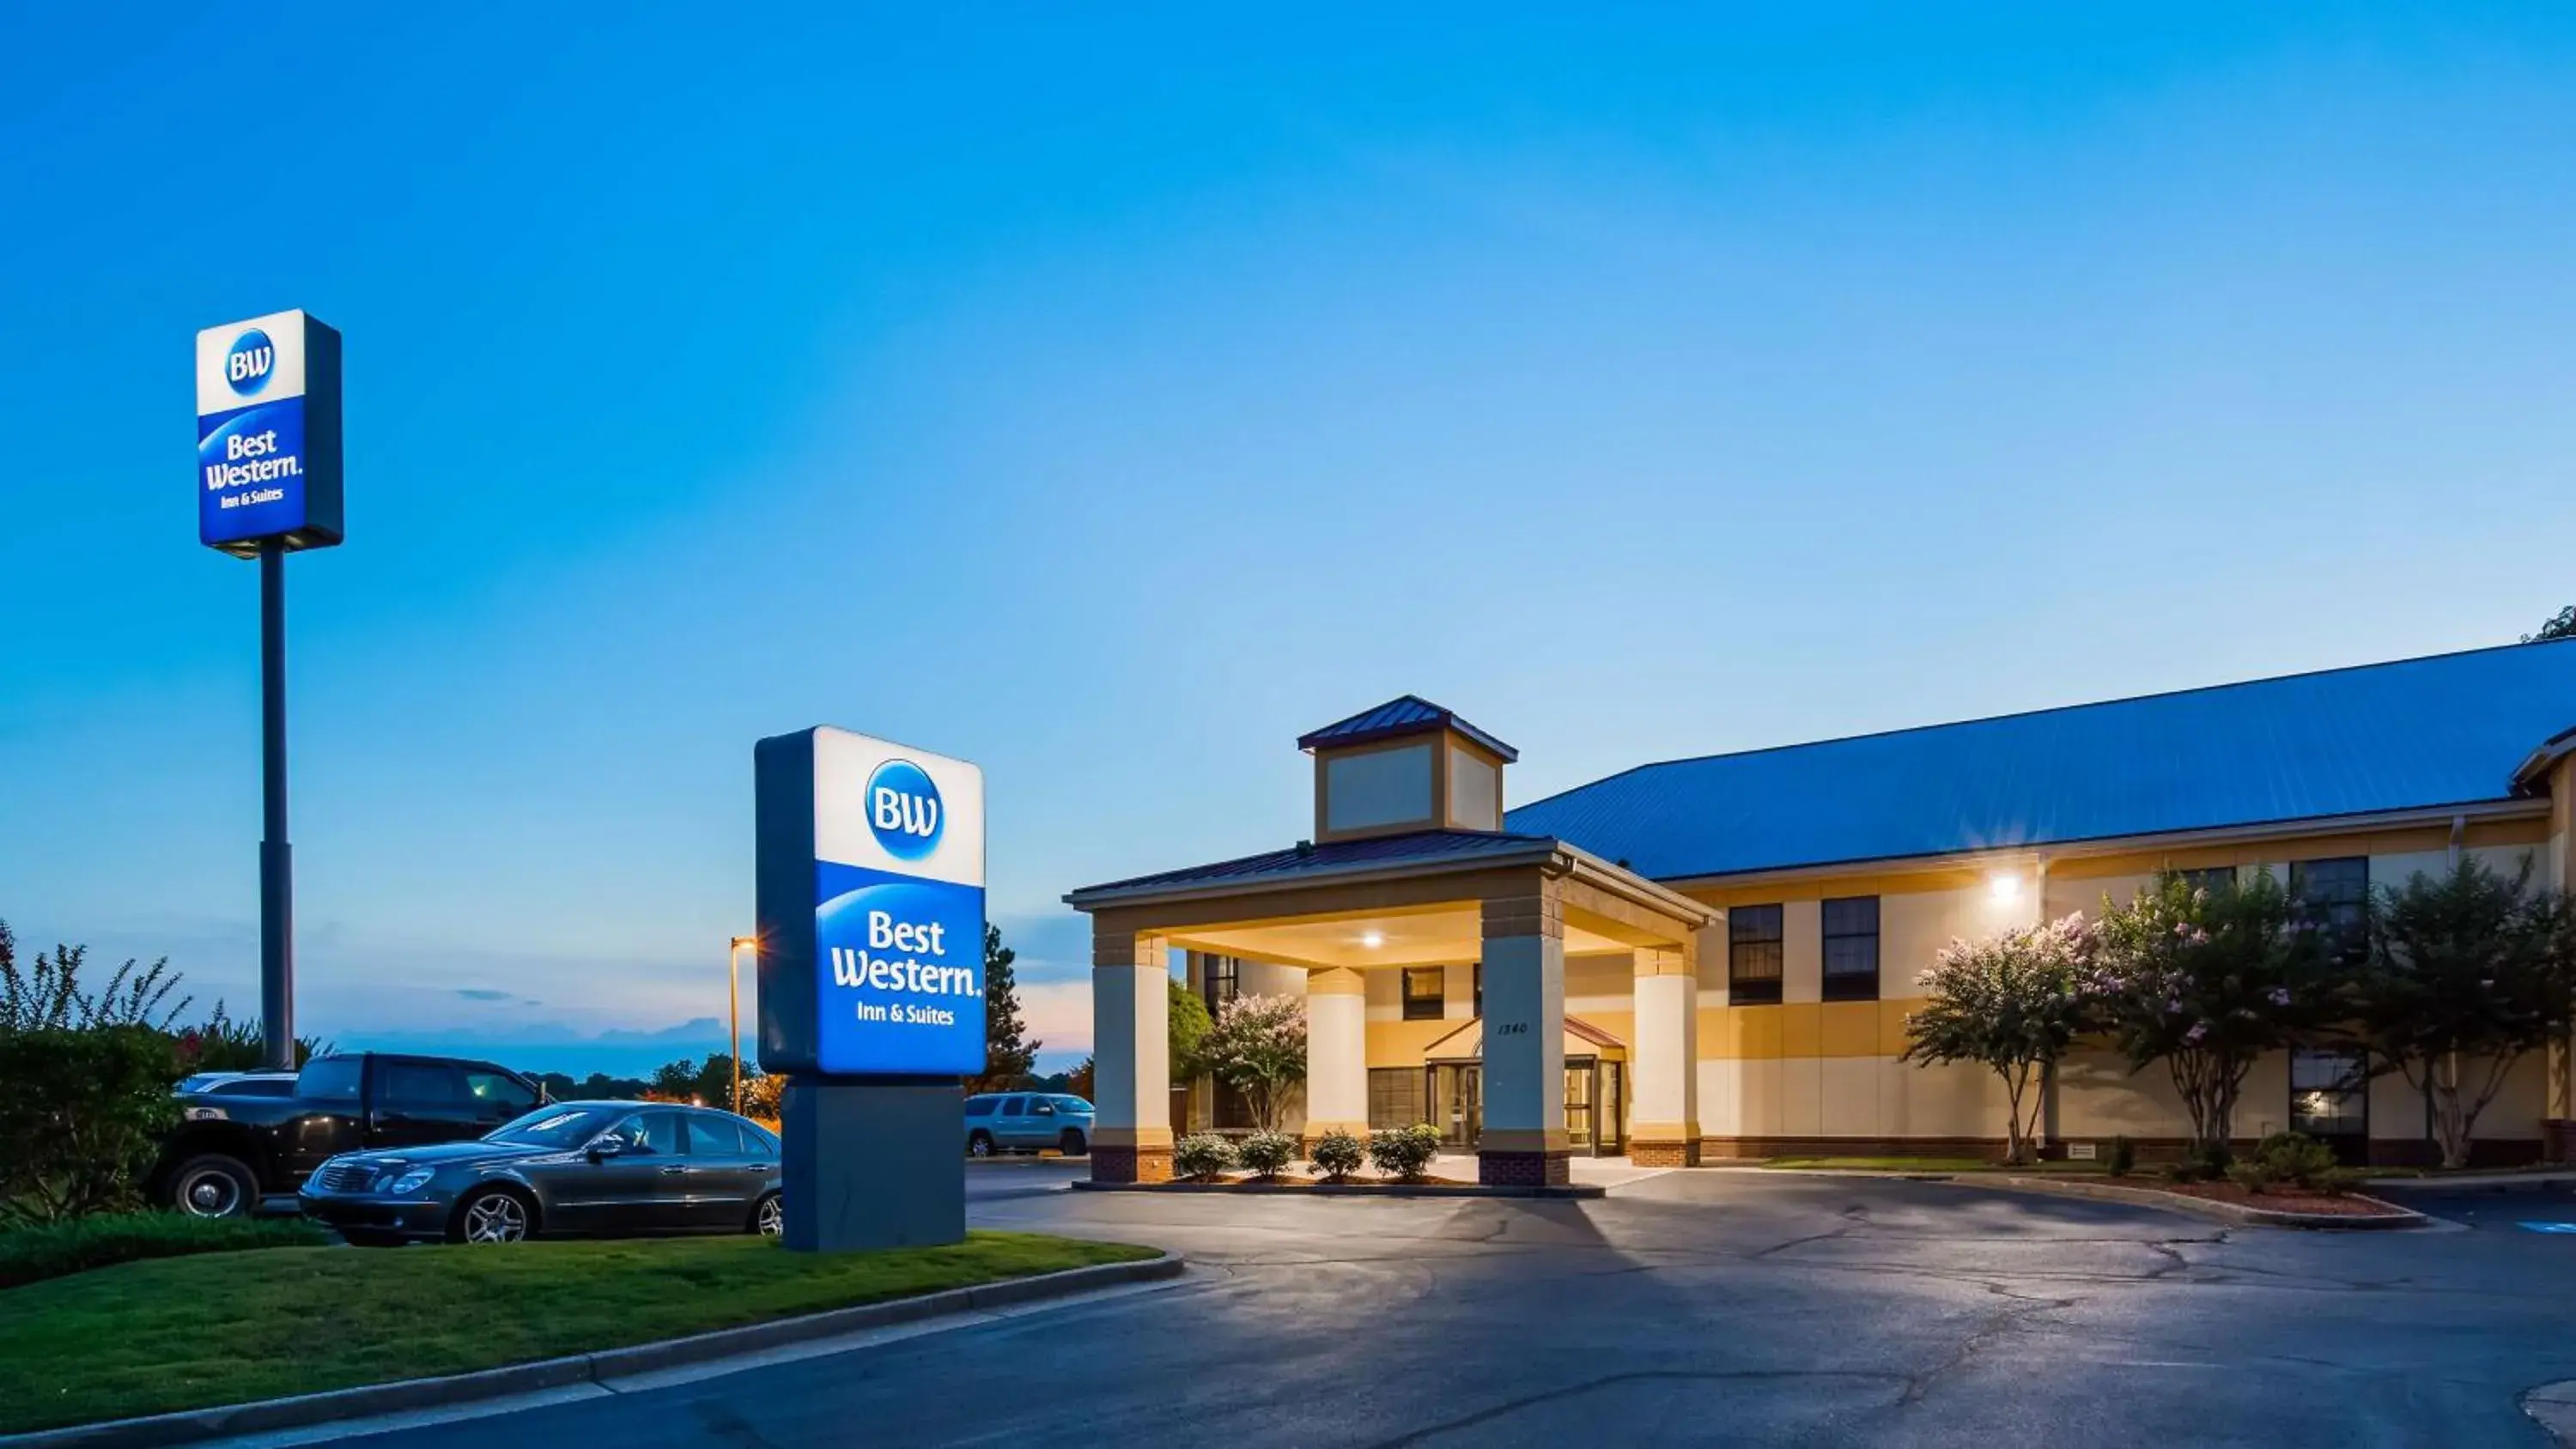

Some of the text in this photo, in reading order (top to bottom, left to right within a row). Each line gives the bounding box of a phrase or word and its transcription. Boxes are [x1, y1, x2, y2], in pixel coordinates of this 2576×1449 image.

[230, 346, 271, 382] BW
[227, 430, 277, 460] Best
[240, 493, 250, 506] &
[875, 786, 938, 838] BW
[869, 910, 945, 955] Best
[857, 1000, 955, 1026] Inn & Suites
